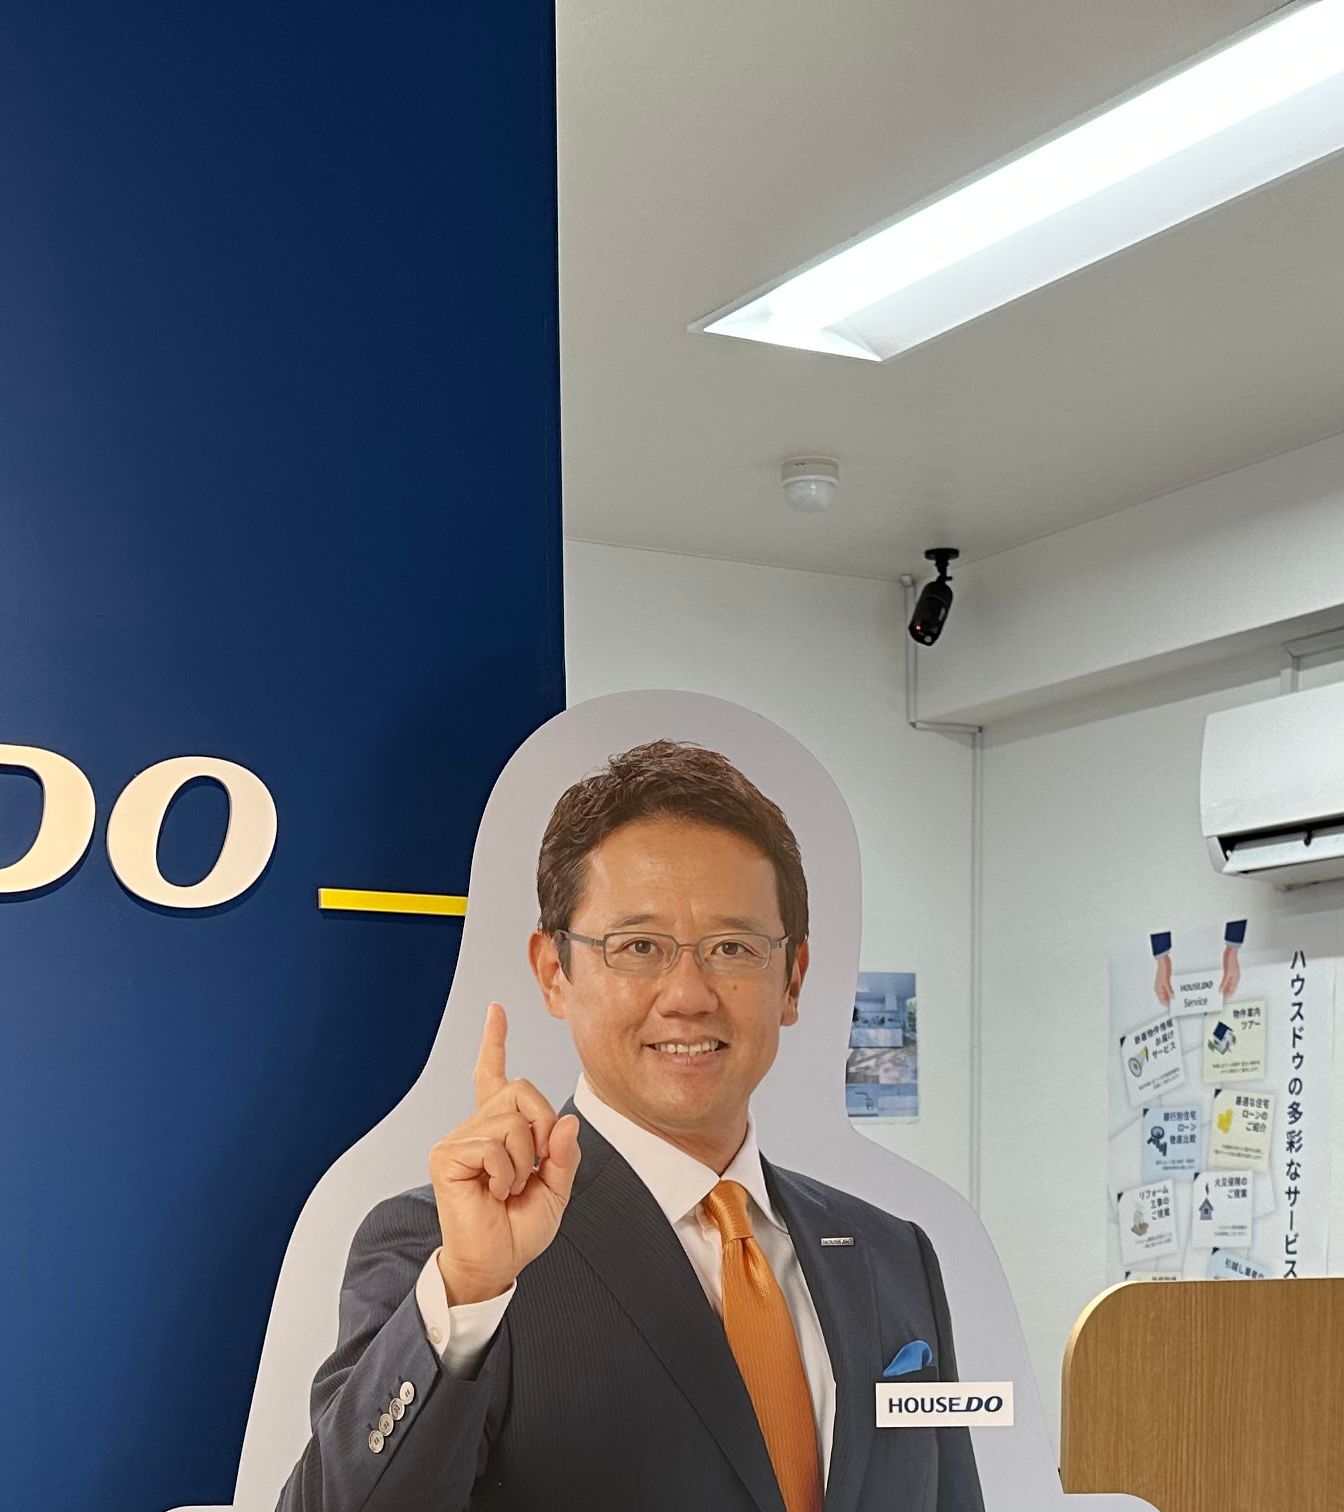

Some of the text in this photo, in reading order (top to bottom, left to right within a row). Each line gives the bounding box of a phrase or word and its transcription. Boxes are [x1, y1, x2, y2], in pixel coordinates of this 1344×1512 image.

[1184, 998, 1208, 1008] Service
[1283, 950, 1306, 1278] ハウスドゥの多彩なサービス
[889, 1395, 1003, 1413] HOUSEDO
